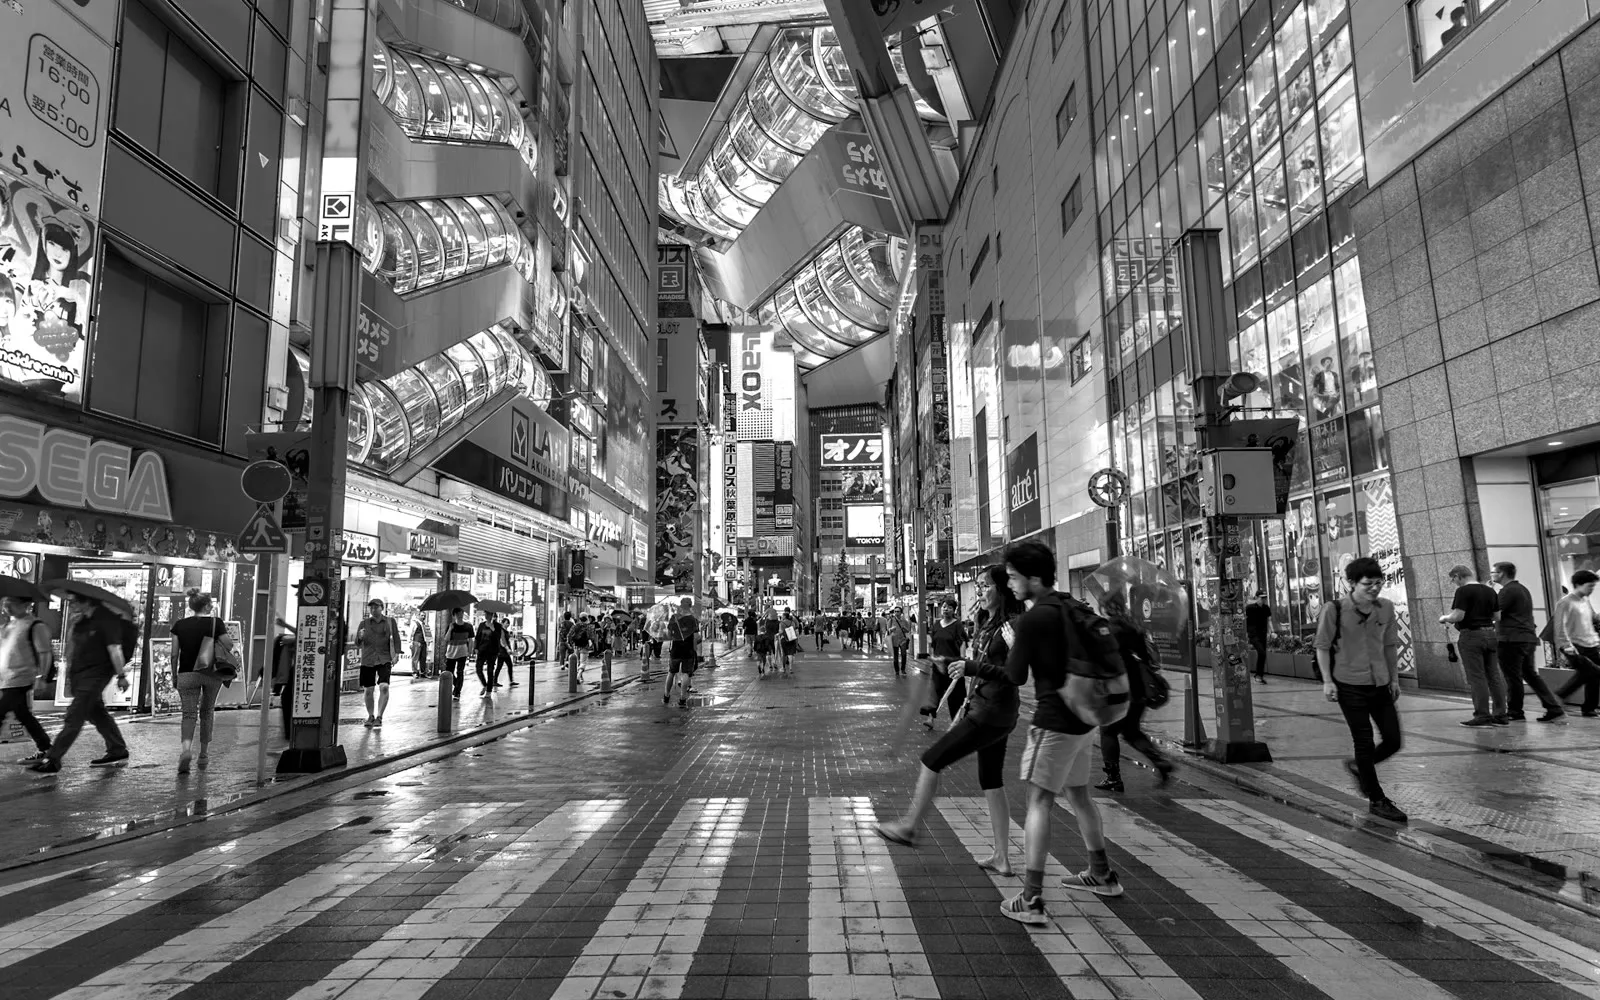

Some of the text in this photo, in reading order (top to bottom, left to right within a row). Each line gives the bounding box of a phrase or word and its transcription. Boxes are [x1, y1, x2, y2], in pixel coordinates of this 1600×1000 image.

[38, 56, 91, 105] 16:00
[43, 44, 90, 87] 営業時間
[31, 94, 89, 141] 翌5:00
[357, 338, 379, 362] メラ
[359, 312, 390, 346] カメラ
[0, 415, 174, 522] SEGA
[1011, 468, 1032, 509] atré
[301, 614, 317, 714] 路上喫煙禁止です。
